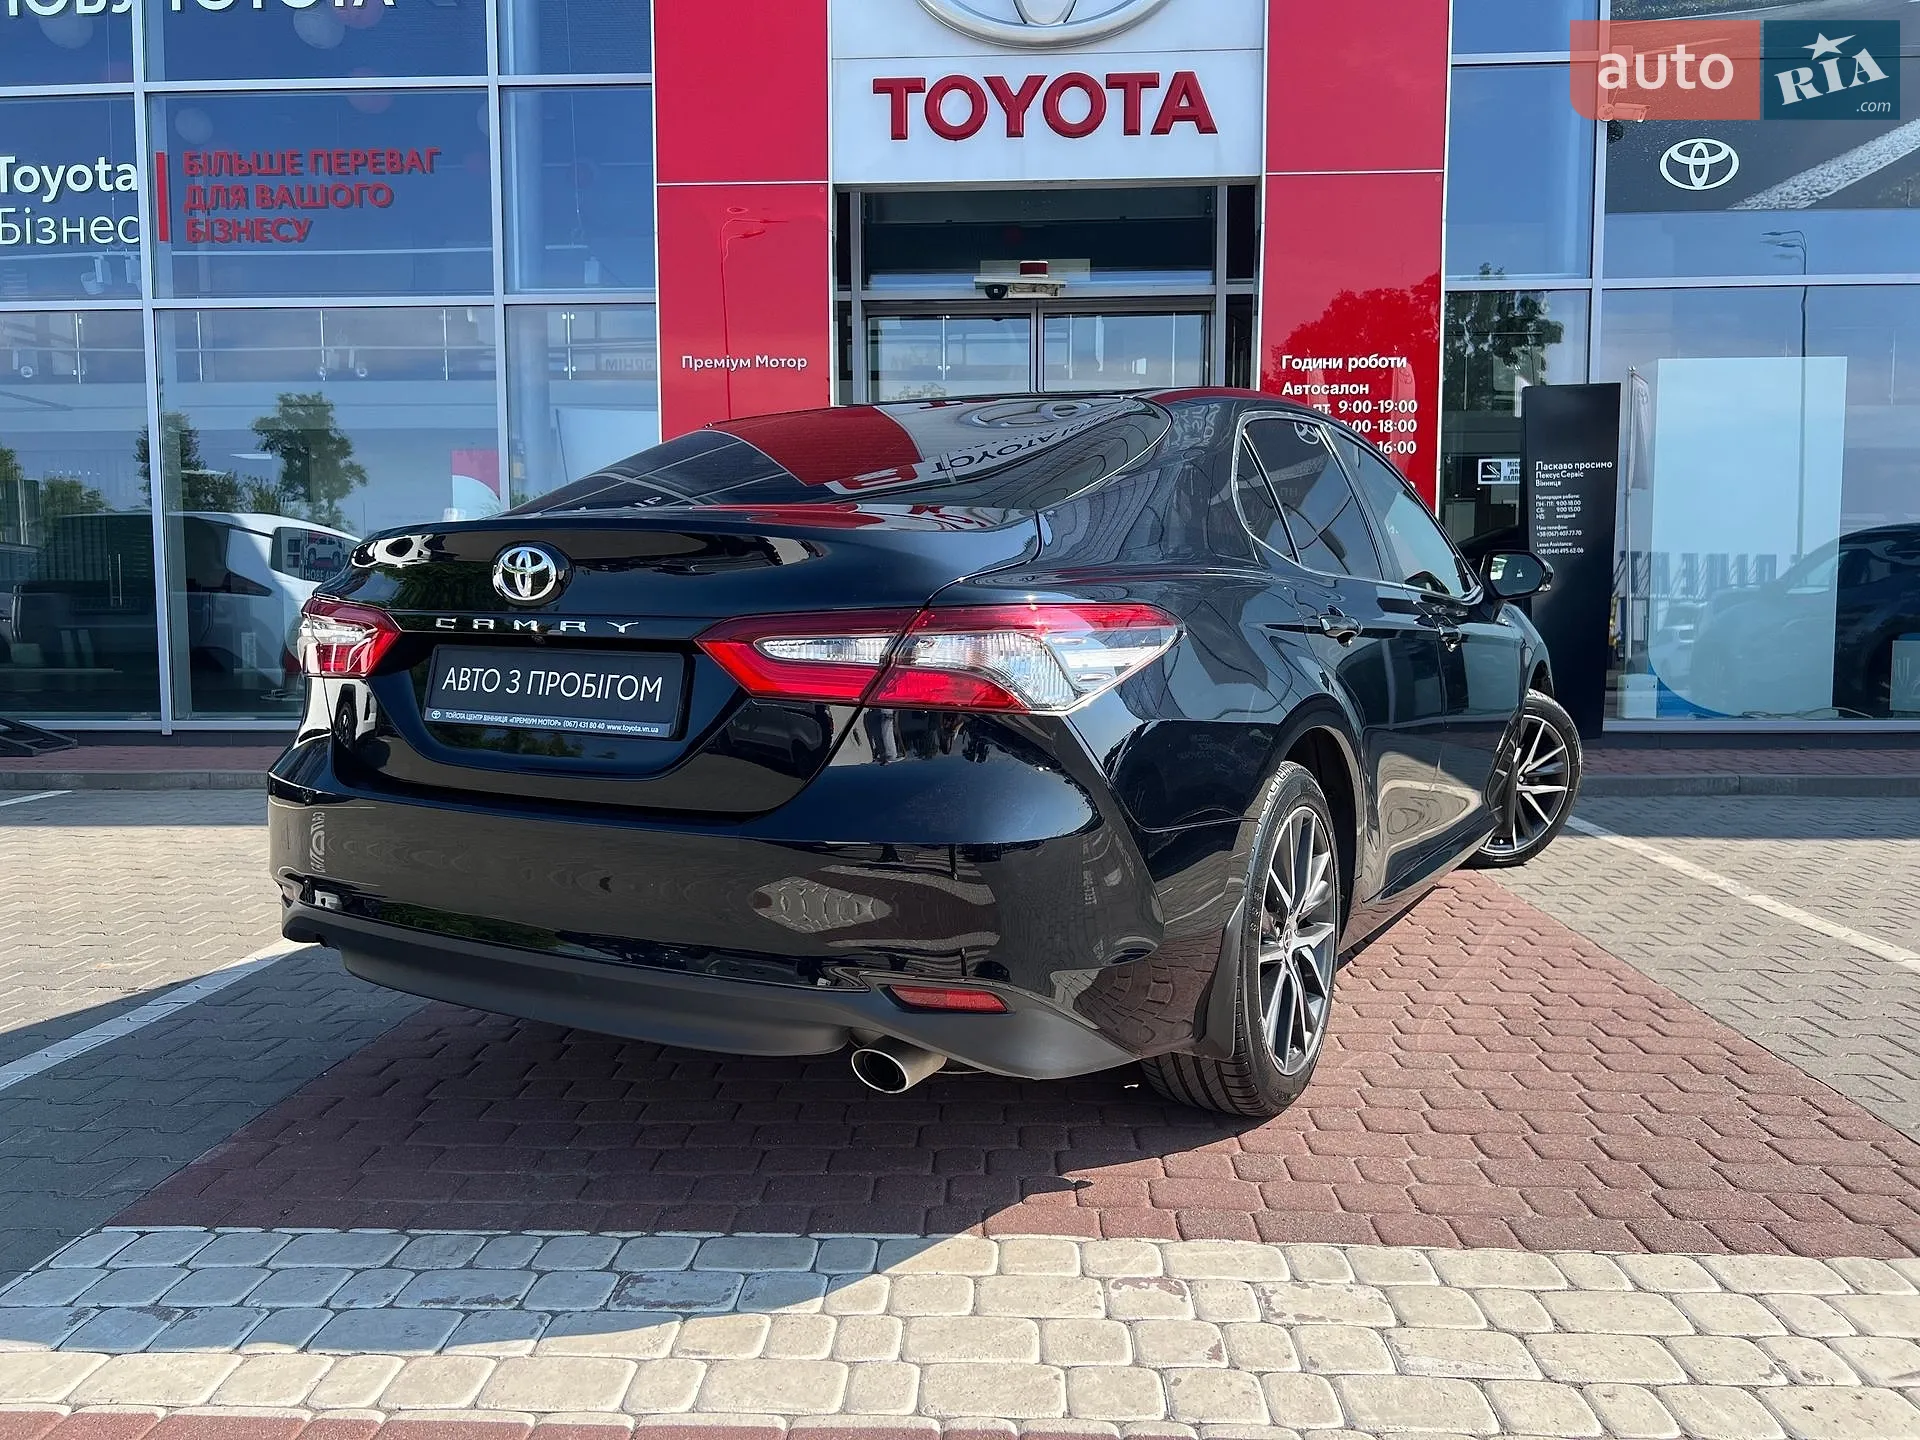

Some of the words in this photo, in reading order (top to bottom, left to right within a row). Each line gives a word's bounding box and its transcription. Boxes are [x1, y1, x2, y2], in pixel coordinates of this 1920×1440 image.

[873, 71, 1218, 141] TOYOTA
[183, 150, 303, 176] БІЛЬШЕ
[309, 148, 441, 175] ПЕРЕВАГ
[0, 156, 138, 202] Toyota
[183, 183, 247, 213] ДЛЯ
[255, 183, 393, 209] ВАШОГО
[0, 207, 140, 244] Бізнес
[185, 217, 312, 243] БІЗНЕСУ
[682, 355, 751, 371] Преміум
[755, 355, 808, 371] Мотор
[1281, 354, 1343, 371] Години
[1348, 353, 1407, 372] роботи
[1281, 381, 1370, 395] Автосалон
[1338, 399, 1418, 414] 9:00-19:00
[1574, 461, 1613, 471] просимо
[435, 617, 640, 634] CAMRY
[441, 667, 501, 693] АВТО
[526, 670, 663, 702] ПРОБІГОМ
[563, 719, 578, 729] (067)
[606, 723, 659, 733] www.toyota.vn.ua
